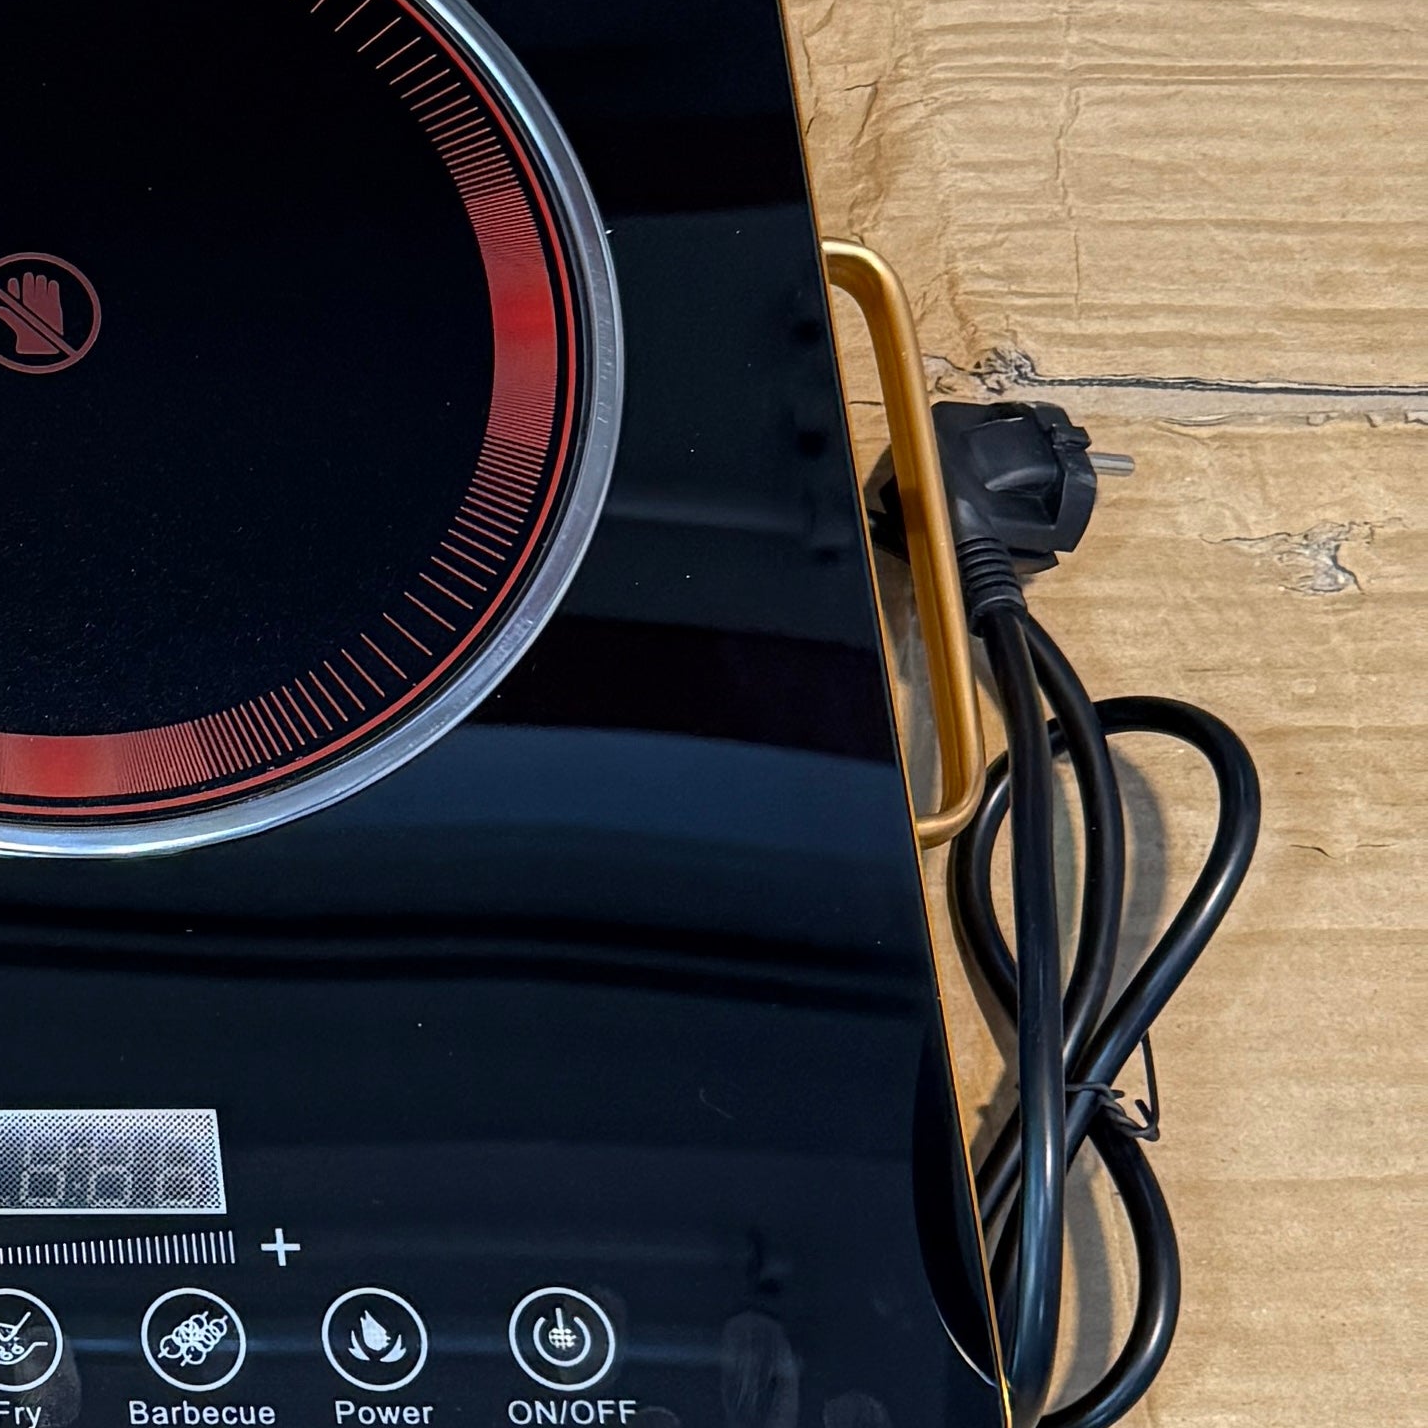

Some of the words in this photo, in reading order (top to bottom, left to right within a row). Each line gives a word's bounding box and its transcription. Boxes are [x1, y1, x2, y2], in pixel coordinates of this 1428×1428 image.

[128, 1400, 276, 1425] Barbecue
[335, 1400, 434, 1425] Power
[508, 1399, 636, 1425] ON/OFF
